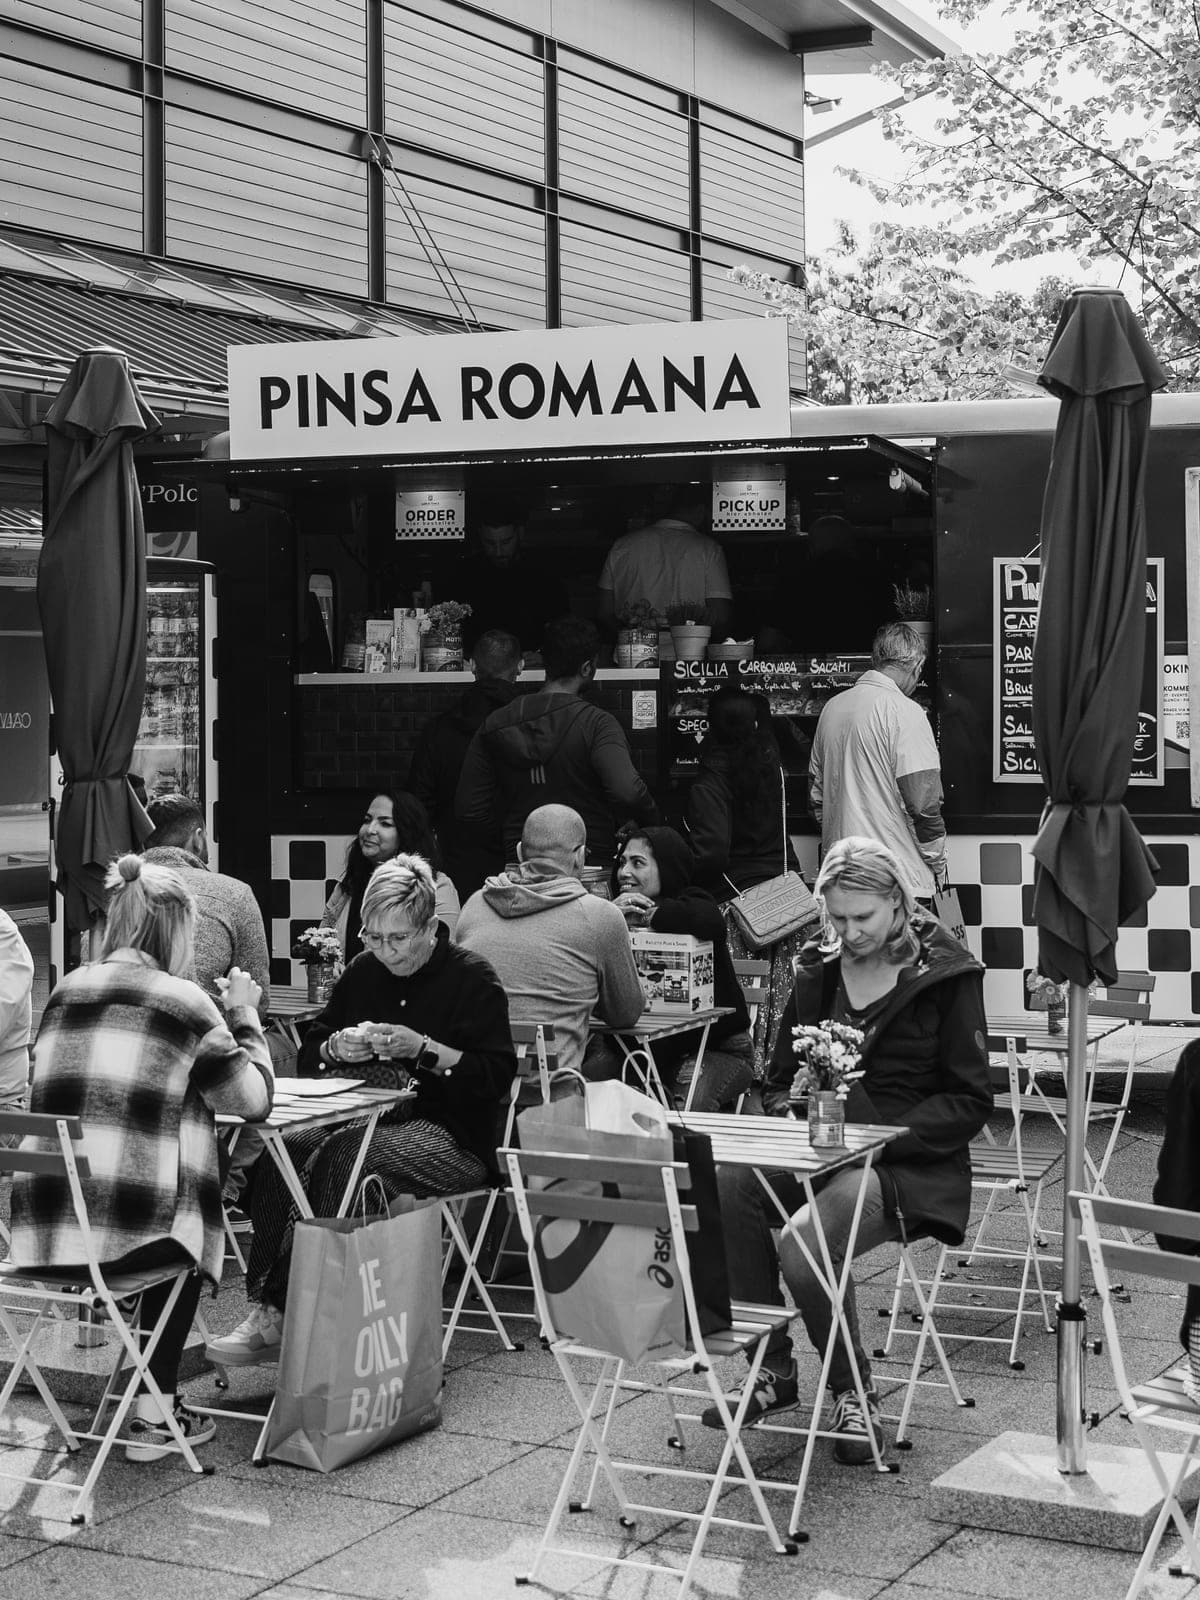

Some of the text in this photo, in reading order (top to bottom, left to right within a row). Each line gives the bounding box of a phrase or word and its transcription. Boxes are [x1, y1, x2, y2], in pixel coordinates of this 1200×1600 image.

[259, 352, 761, 430] PINSA ROMANA
[718, 499, 781, 512] PICK UP
[405, 509, 456, 522] ORDER
[673, 660, 729, 678] SICILIA
[738, 659, 797, 674] CARBONARA
[1003, 750, 1040, 772] SICI
[347, 1376, 404, 1436] BAG
